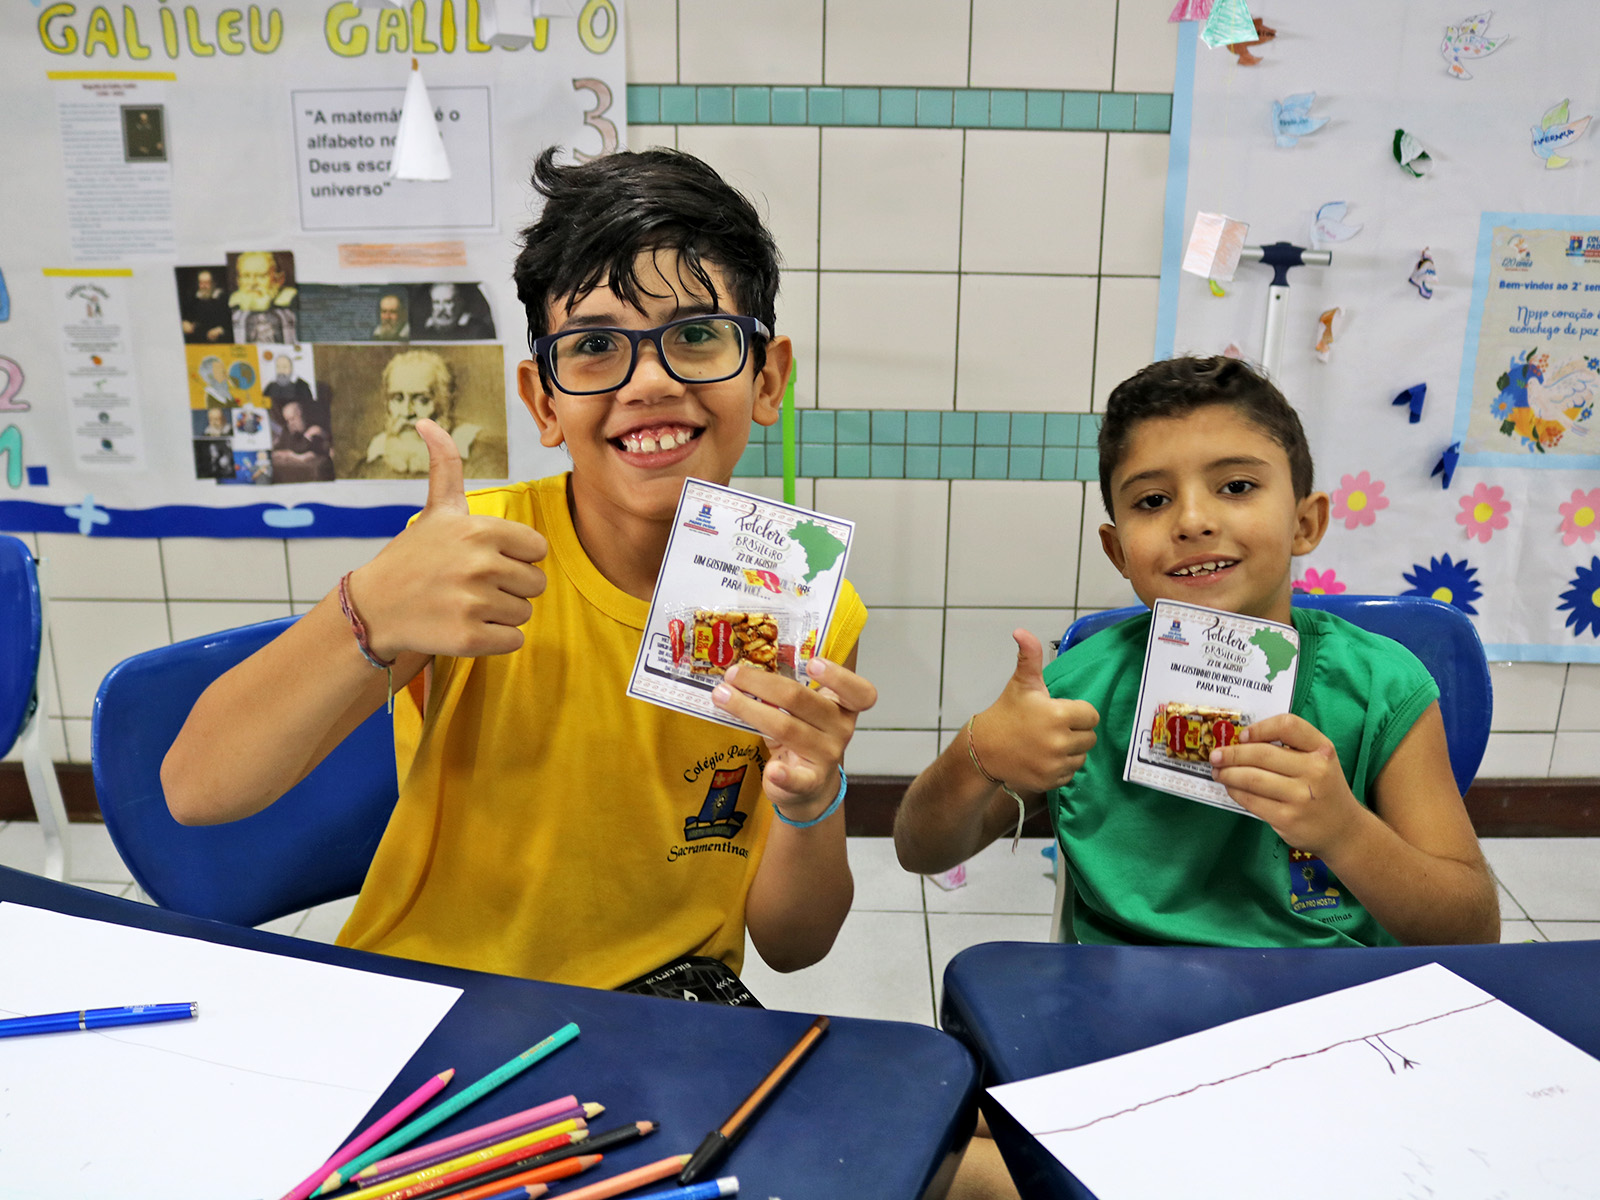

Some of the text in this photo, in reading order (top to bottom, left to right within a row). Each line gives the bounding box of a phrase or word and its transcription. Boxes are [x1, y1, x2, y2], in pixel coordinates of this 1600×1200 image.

[38, 2, 284, 59] GALILEU
[449, 109, 461, 122] o
[307, 134, 375, 150] alfabeto
[309, 158, 352, 174] Deus
[310, 181, 392, 198] universo"
[1499, 280, 1553, 291] Bem-vindos
[1556, 282, 1568, 291] ao
[1551, 308, 1594, 322] coração
[1508, 321, 1599, 341] aconchego de paz
[734, 502, 786, 546] Folclore
[693, 554, 705, 566] UM
[745, 554, 754, 564] DE
[721, 577, 741, 591] PARA
[1201, 616, 1248, 651] Folclore
[1170, 662, 1273, 694] UM GOSTINHO DO NOSSO FOLCLORE
[1195, 680, 1214, 692] PARA
[683, 751, 725, 783] Colégio
[666, 841, 749, 862] Sacramentinas
